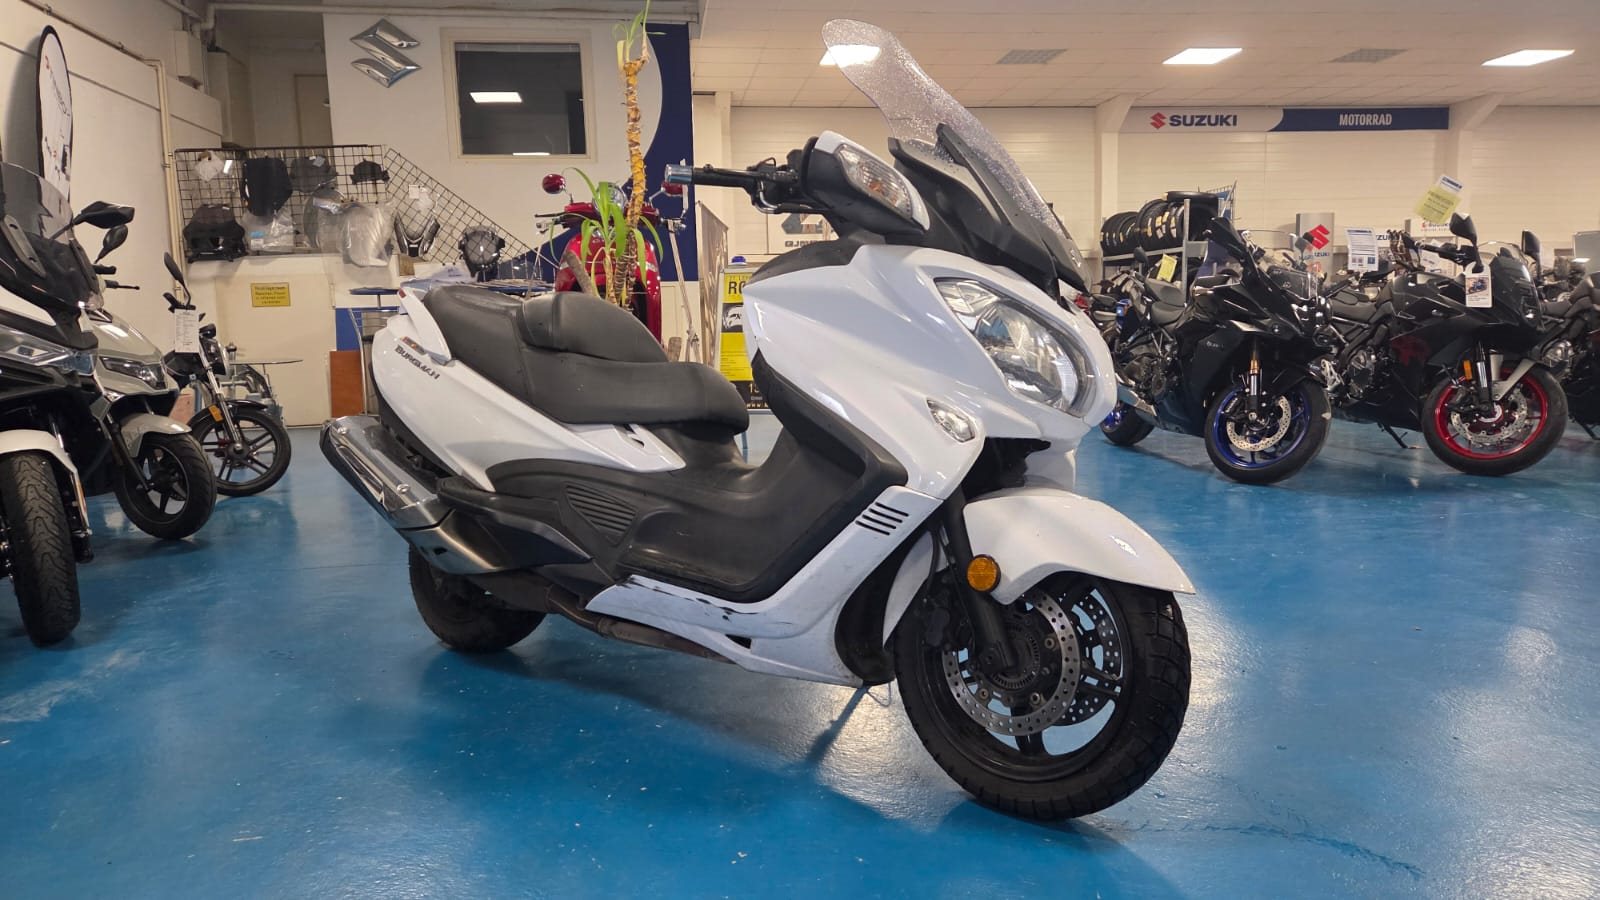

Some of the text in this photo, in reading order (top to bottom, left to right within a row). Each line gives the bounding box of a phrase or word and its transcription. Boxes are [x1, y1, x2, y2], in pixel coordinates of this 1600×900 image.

[1169, 114, 1238, 127] SUZUKI
[1339, 113, 1393, 126] MOTORRAD
[394, 344, 440, 379] BURGMAN
